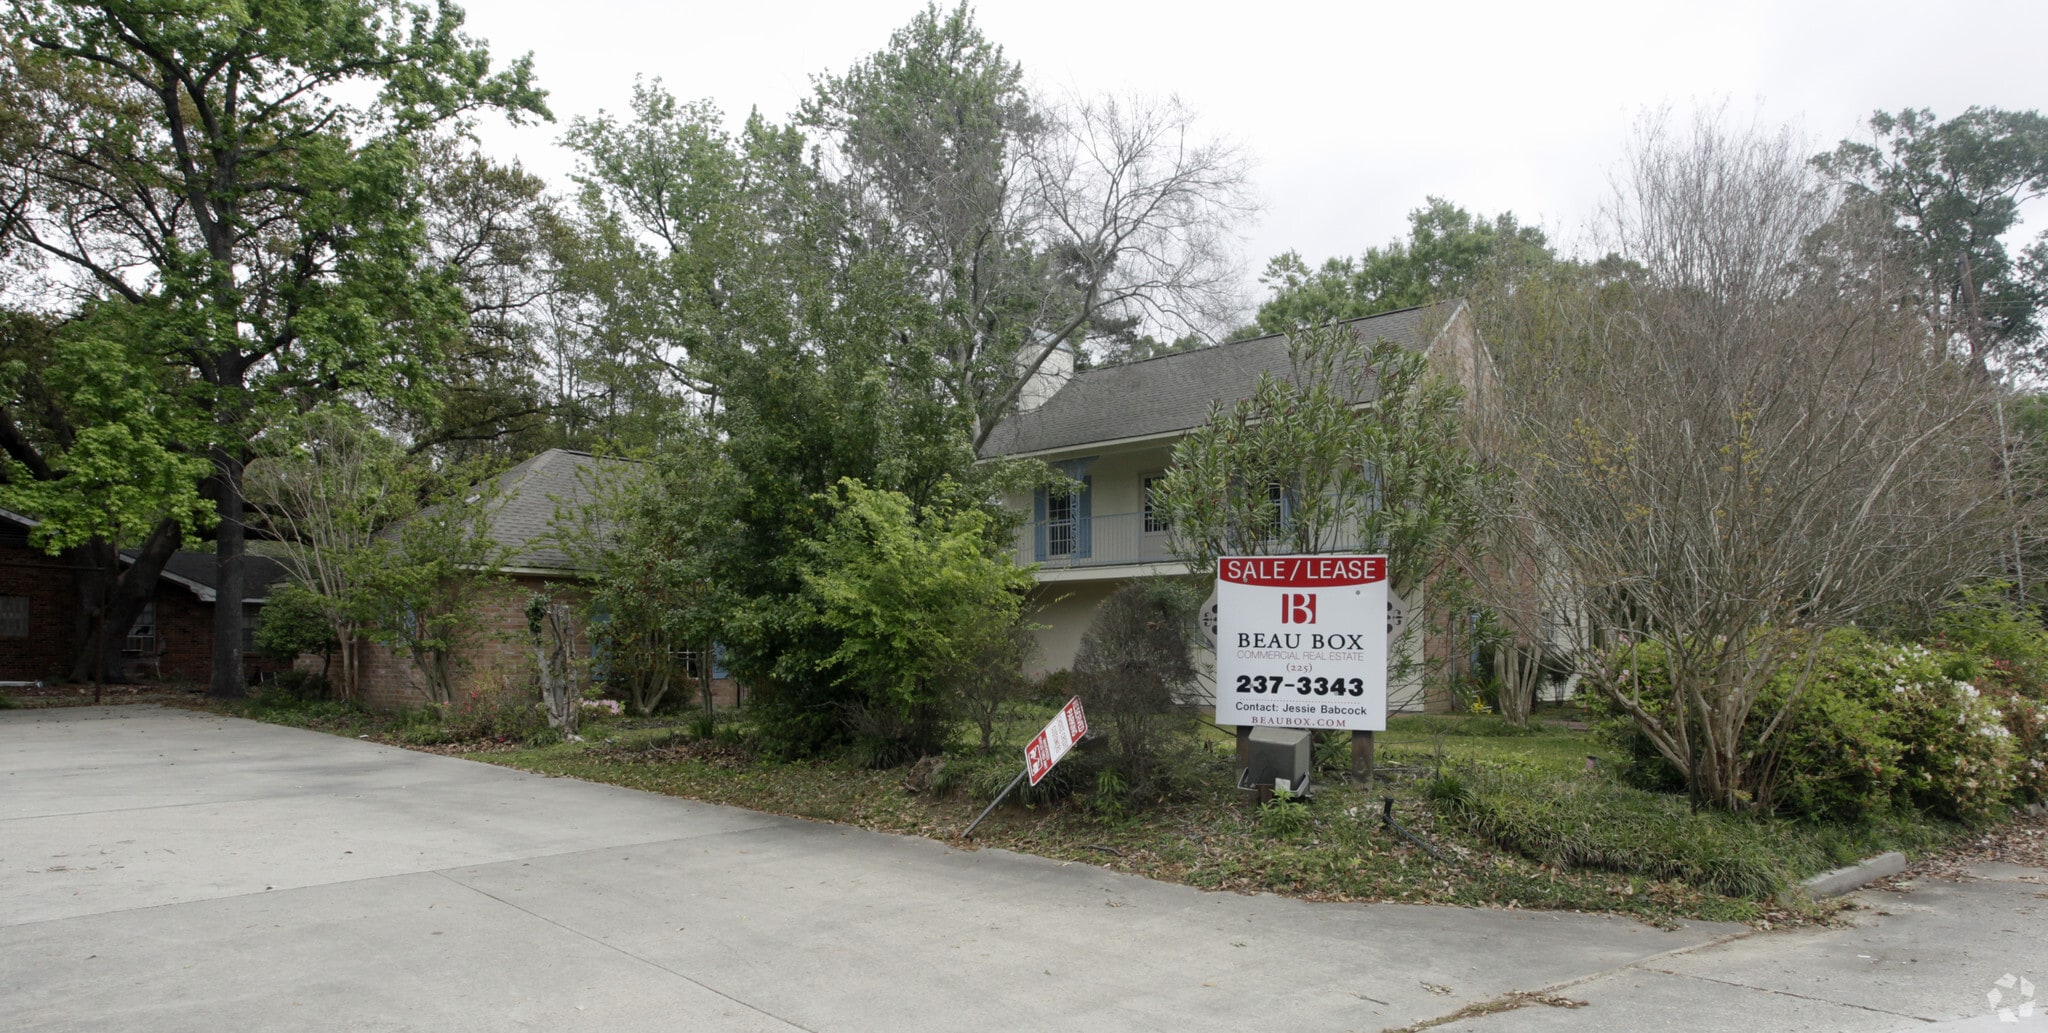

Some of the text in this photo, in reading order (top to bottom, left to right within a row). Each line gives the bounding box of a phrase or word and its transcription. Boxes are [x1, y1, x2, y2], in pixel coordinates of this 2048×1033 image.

[1238, 633, 1364, 650] BEAU BOX
[1237, 650, 1364, 661] COMMERCIAL REAL ESTATE
[1286, 663, 1313, 673] (225)
[1236, 675, 1364, 697] 237-3343
[1235, 702, 1367, 715] Contact: Jessie Babcock
[1066, 708, 1078, 737] PARKING
[1251, 716, 1346, 727] BEAUBOX.COM
